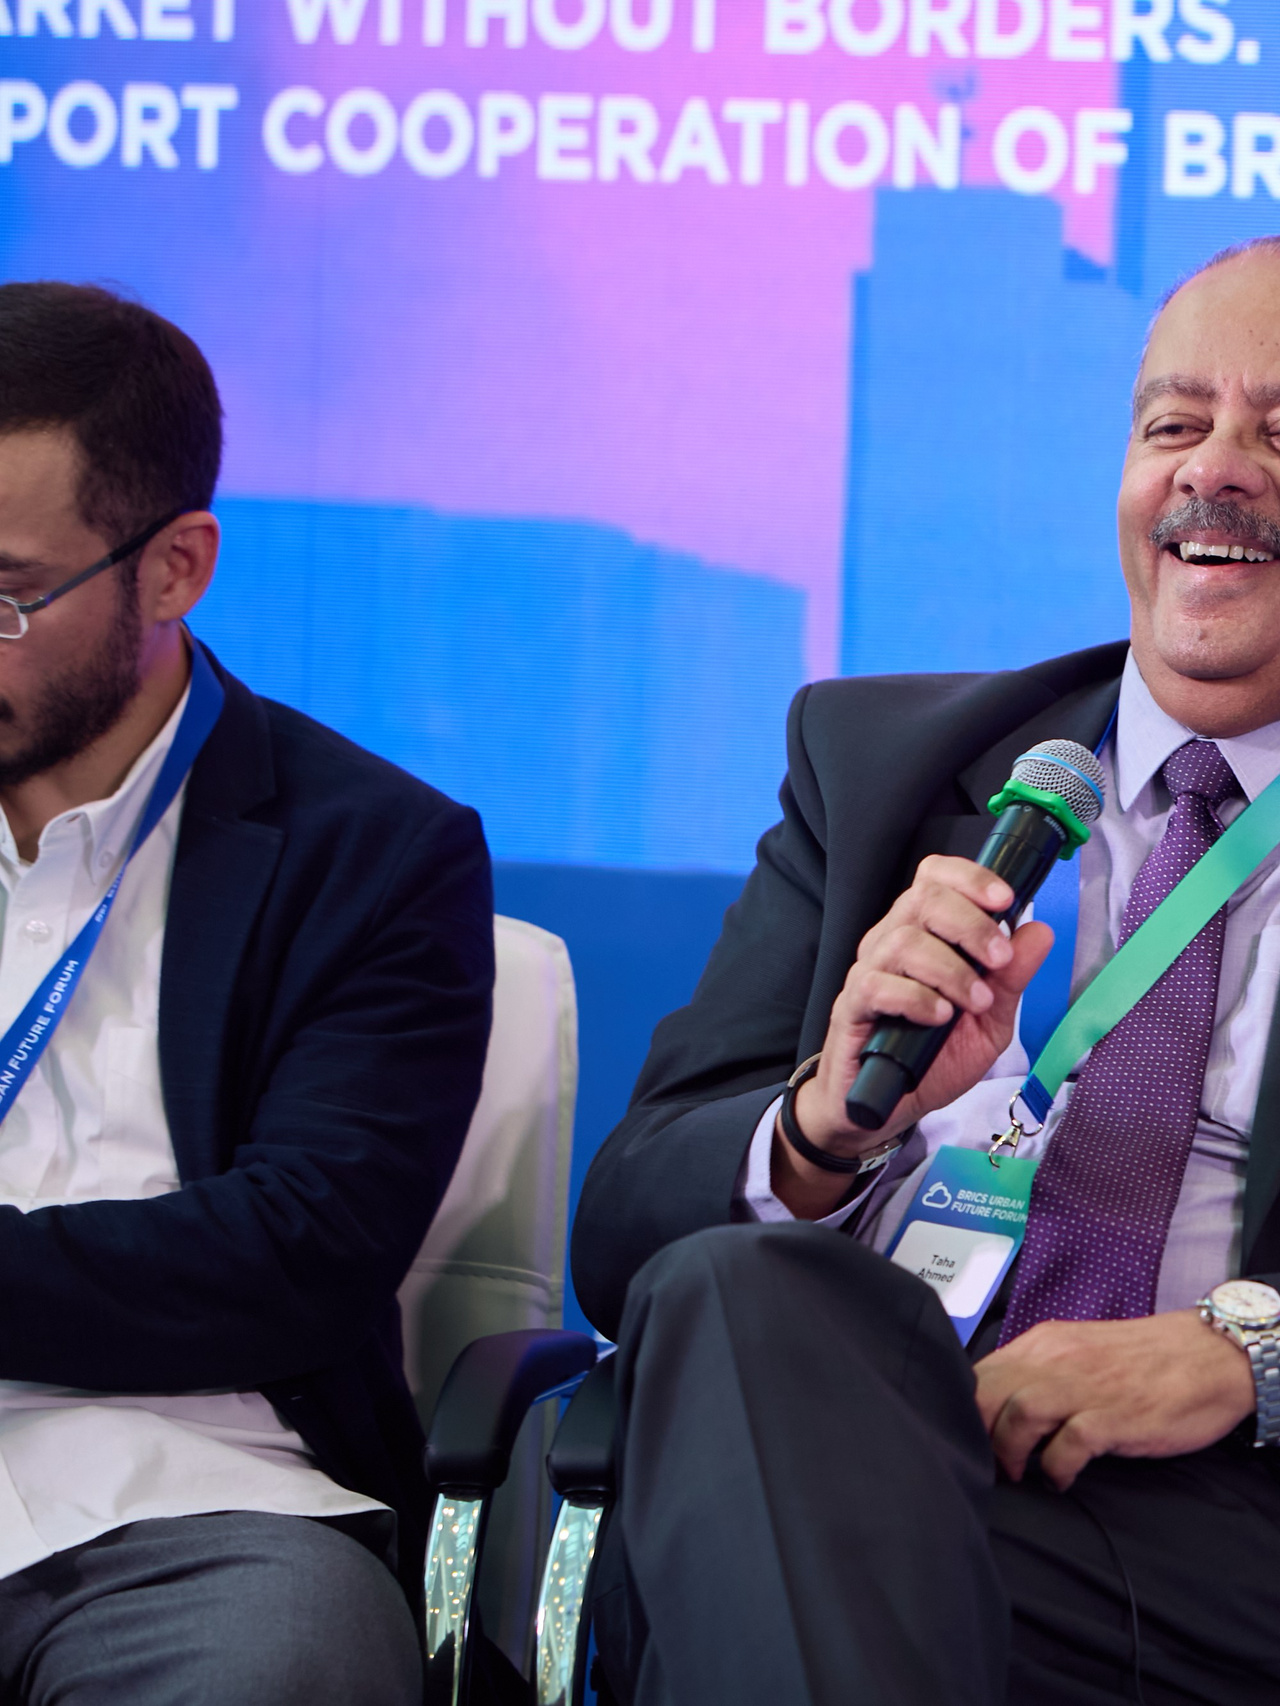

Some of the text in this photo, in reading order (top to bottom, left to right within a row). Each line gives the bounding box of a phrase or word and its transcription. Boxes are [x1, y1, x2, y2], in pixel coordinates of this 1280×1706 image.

[763, 0, 1262, 67] BORDERS.
[0, 80, 239, 170] PORT
[262, 87, 962, 193] COOPERATION
[991, 105, 1134, 197] OF
[0, 959, 79, 1104] AN FUTURE FORUM
[956, 1188, 1026, 1210] BRICS URBAN
[950, 1200, 1028, 1224] FUTURE FORUM
[931, 1254, 956, 1269] Taha
[918, 1267, 955, 1283] Ahmed
